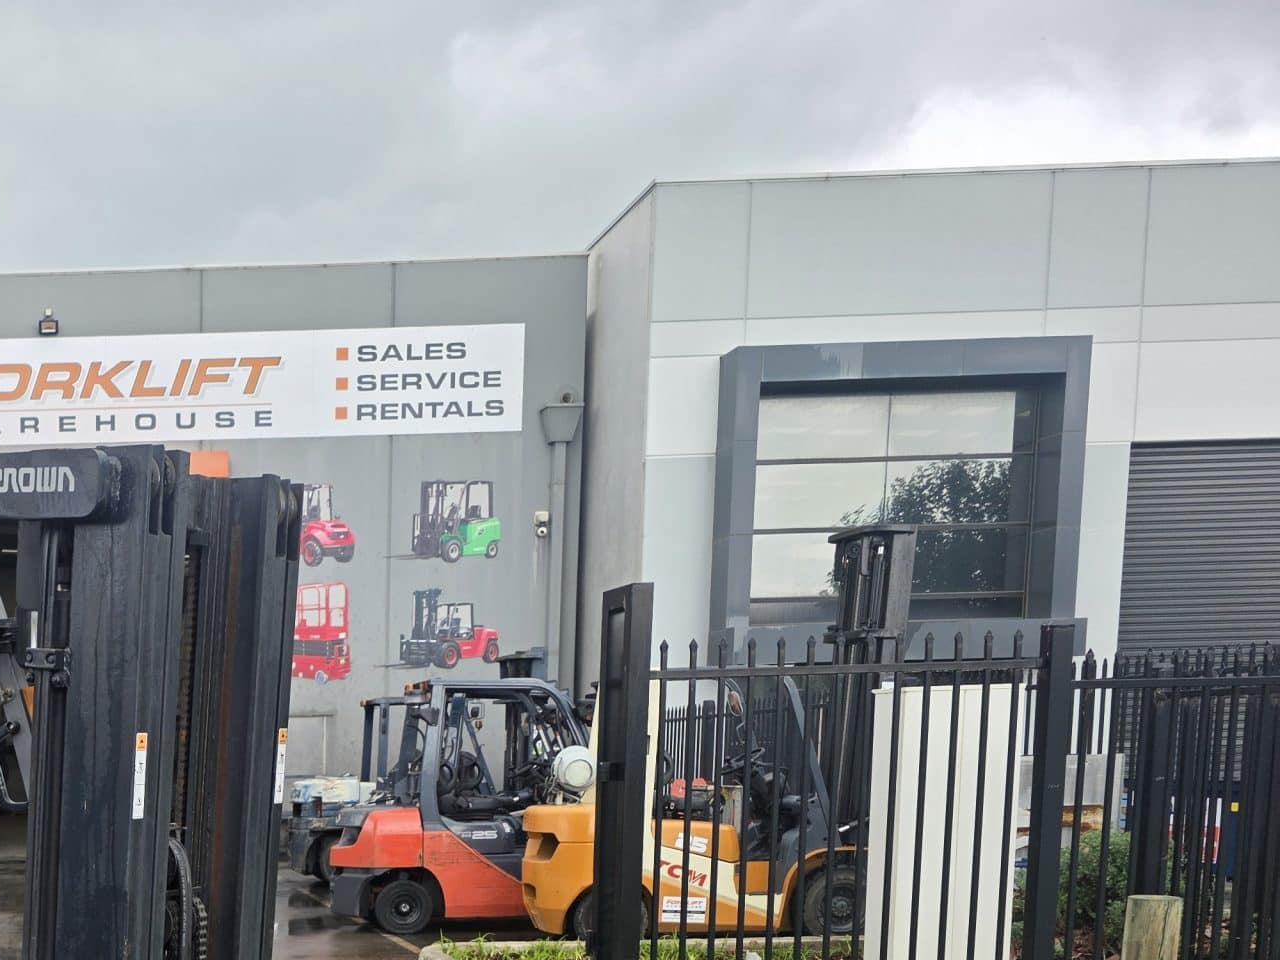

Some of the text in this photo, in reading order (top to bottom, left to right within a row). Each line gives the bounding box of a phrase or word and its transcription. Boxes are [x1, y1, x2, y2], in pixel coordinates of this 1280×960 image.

[357, 342, 467, 362] SALES
[356, 370, 502, 391] SERVICE
[356, 399, 505, 421] RENTALS
